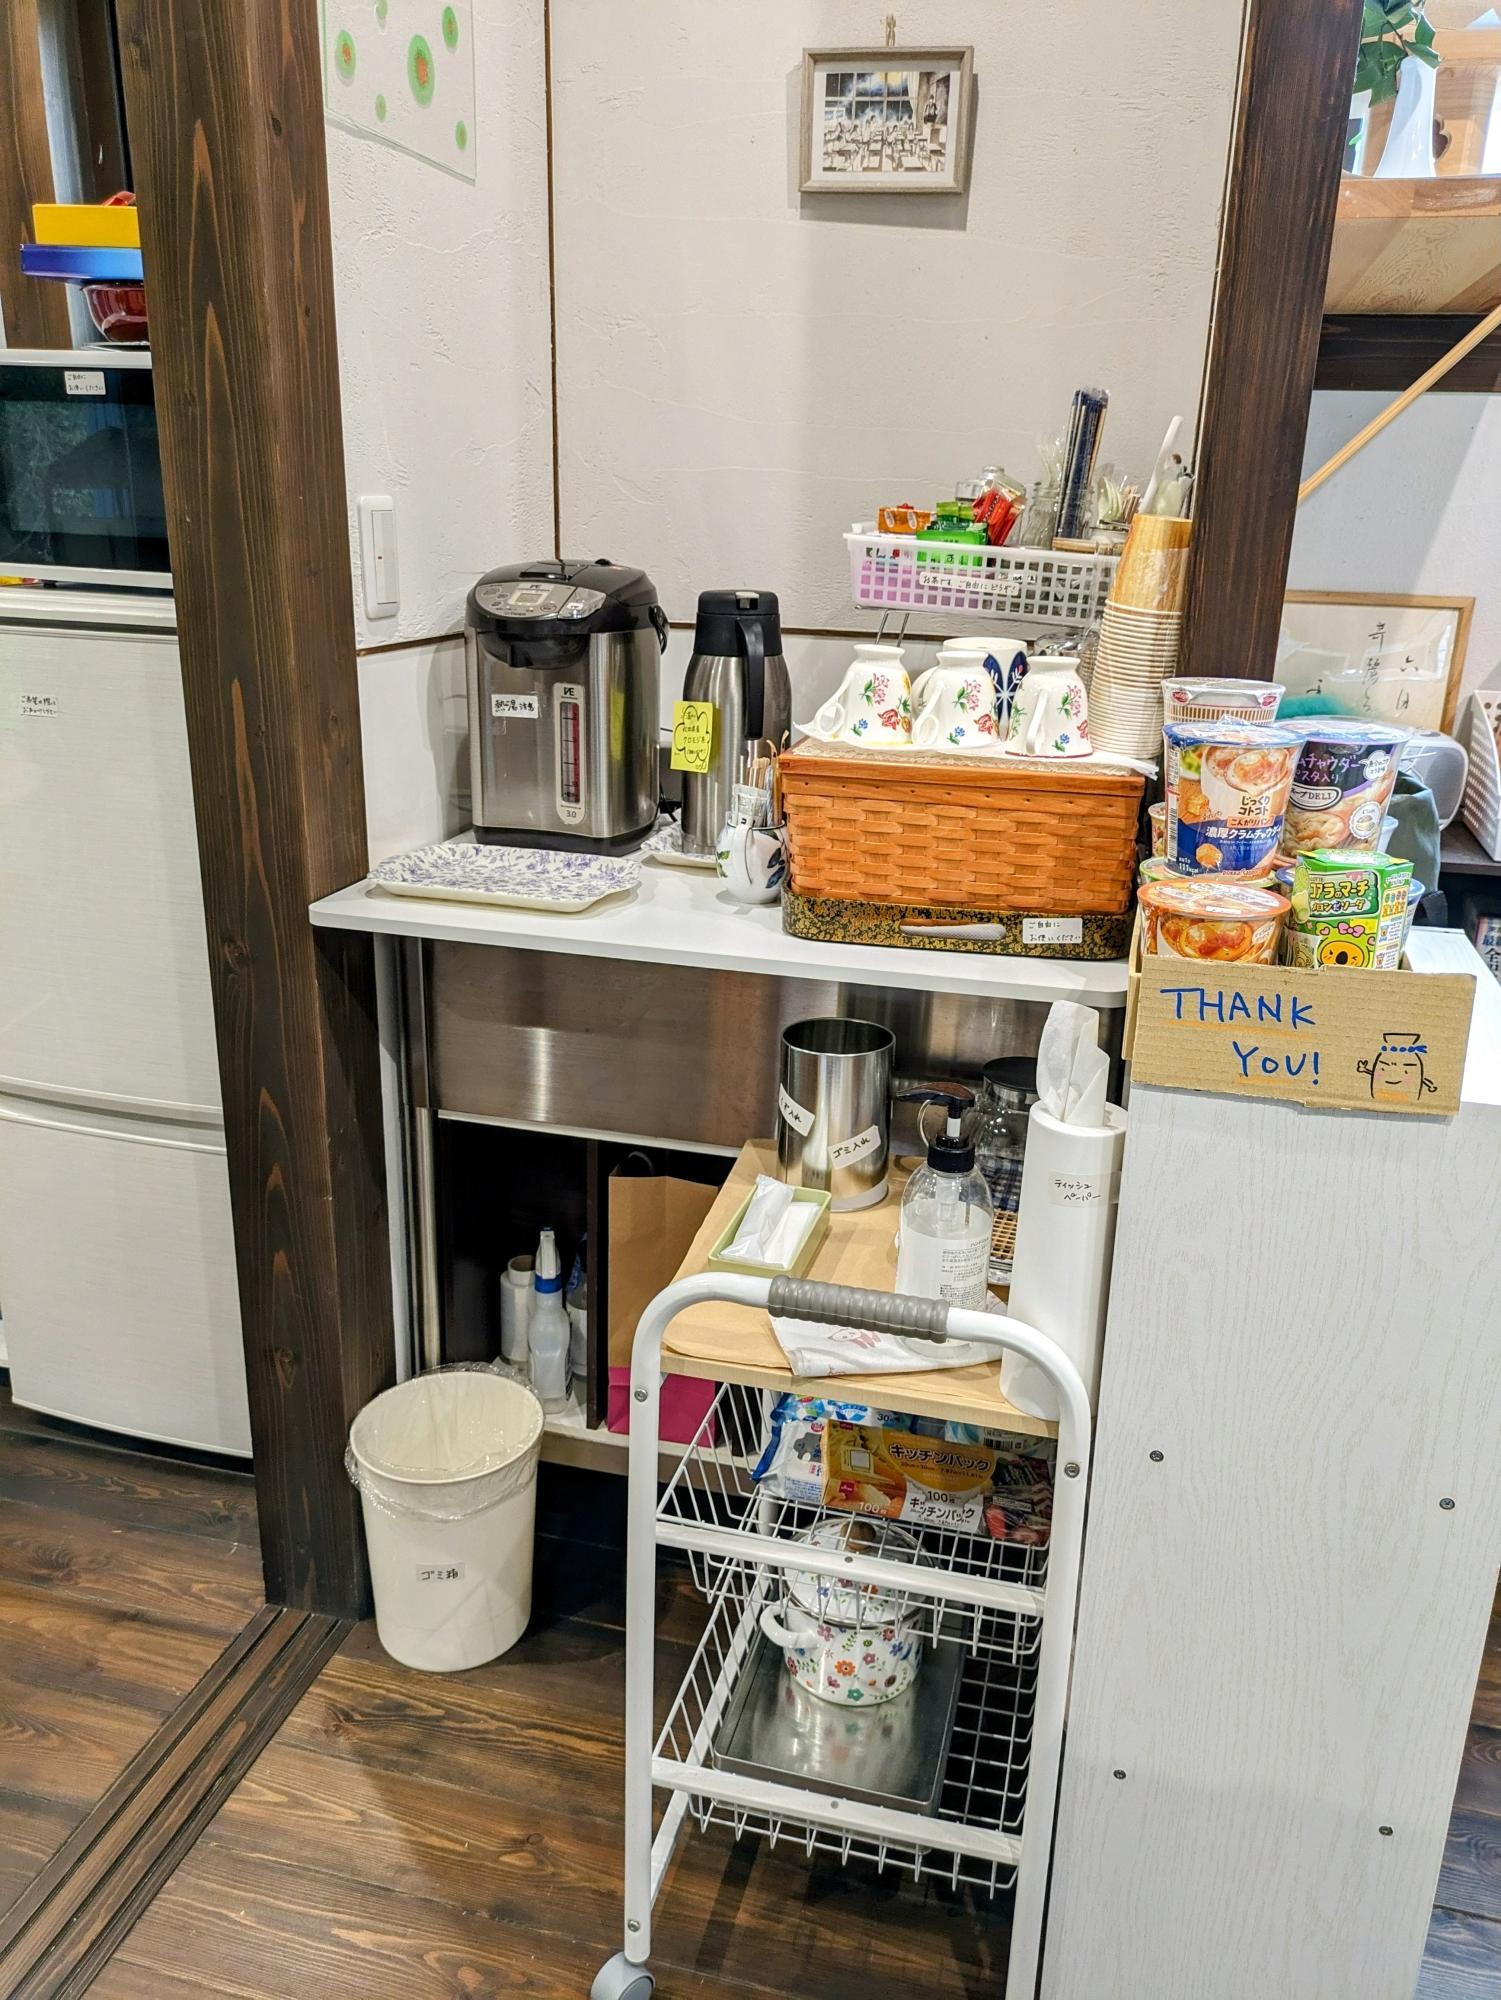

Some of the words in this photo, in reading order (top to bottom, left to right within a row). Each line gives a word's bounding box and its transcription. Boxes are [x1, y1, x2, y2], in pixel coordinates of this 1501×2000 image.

[1241, 795, 1271, 807] じっくり
[566, 810, 577, 818] 3.0
[1238, 806, 1270, 817] コトコト
[1310, 880, 1370, 900] コアラのマーチ
[1028, 920, 1061, 930] ご自由に
[1159, 986, 1317, 1030] THANK
[832, 1136, 871, 1159] ゴミ入れ
[1054, 1179, 1093, 1190] ティッシュ
[1063, 1192, 1102, 1202] ペーパー
[889, 1443, 990, 1472] キッチンパック
[420, 1568, 459, 1581] ゴミ箱
